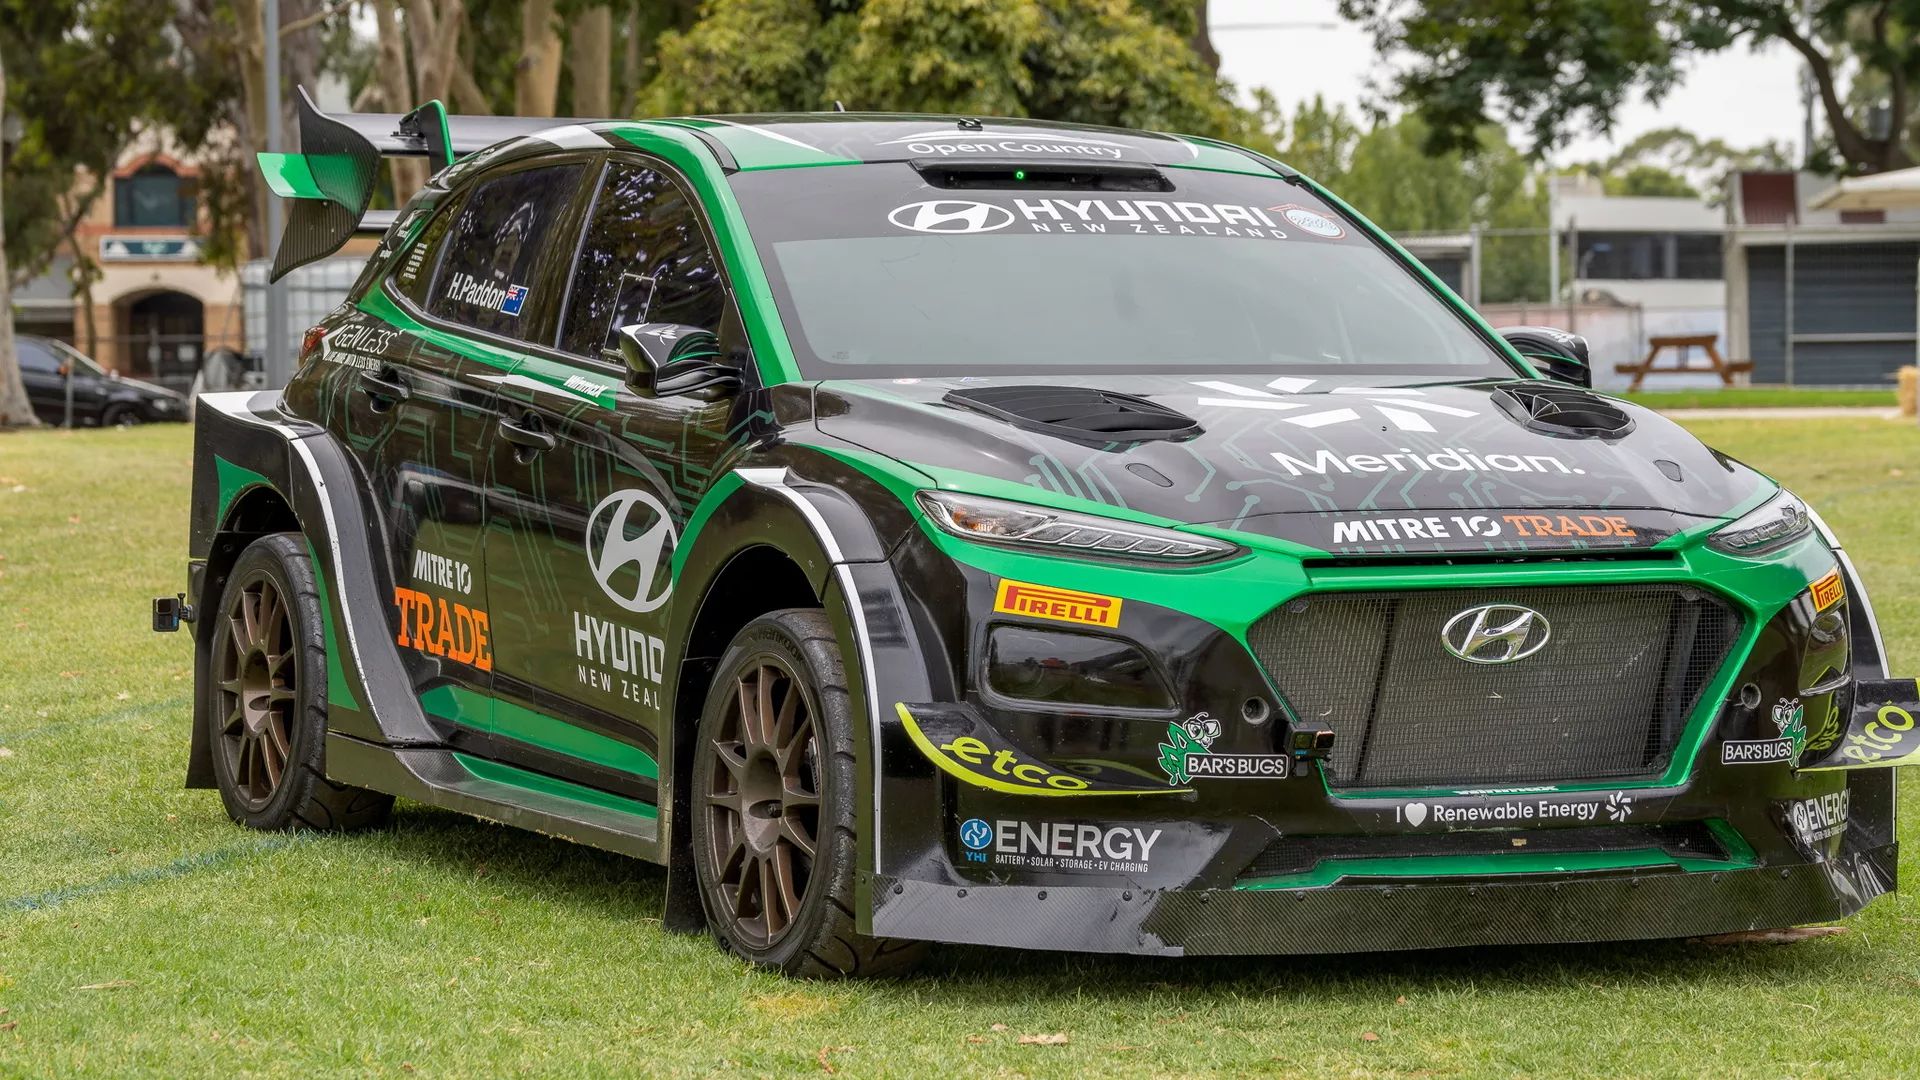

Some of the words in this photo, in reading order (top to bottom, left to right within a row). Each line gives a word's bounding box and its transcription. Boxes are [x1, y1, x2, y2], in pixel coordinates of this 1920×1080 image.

[907, 142, 998, 156] Open
[999, 142, 1122, 159] Country
[1013, 199, 1277, 228] HYUNDAI
[1031, 223, 1105, 233] NEW
[1130, 224, 1287, 239] ZEALAND
[447, 272, 506, 311] H.Paddon
[1270, 448, 1586, 477] Meridian.
[1333, 516, 1448, 544] MITRE
[1450, 515, 1501, 538] 10
[1502, 515, 1636, 538] TRADE
[413, 549, 453, 591] MITRE
[455, 561, 472, 595] 10
[1003, 585, 1112, 623] PIRELLI
[1813, 573, 1842, 609] PIRELLI
[394, 587, 492, 673] TRADE
[578, 664, 611, 692] NEW
[1843, 705, 1915, 763] etco
[940, 736, 1089, 791] etco
[1725, 744, 1762, 760] BAR'S
[1763, 741, 1792, 759] BUGS
[1188, 757, 1237, 775] BAR'S
[1238, 757, 1284, 775] BUGS
[1396, 806, 1401, 823] I
[1434, 802, 1534, 822] Renewable
[1539, 801, 1599, 820] Energy
[996, 820, 1163, 862] ENERGY
[965, 852, 988, 863] YHI
[995, 854, 1026, 865] BATTERY
[1030, 857, 1054, 867] SOLAR
[1060, 859, 1093, 870] STORAGE
[1099, 861, 1109, 871] EV
[1110, 862, 1149, 873] CHARGING
